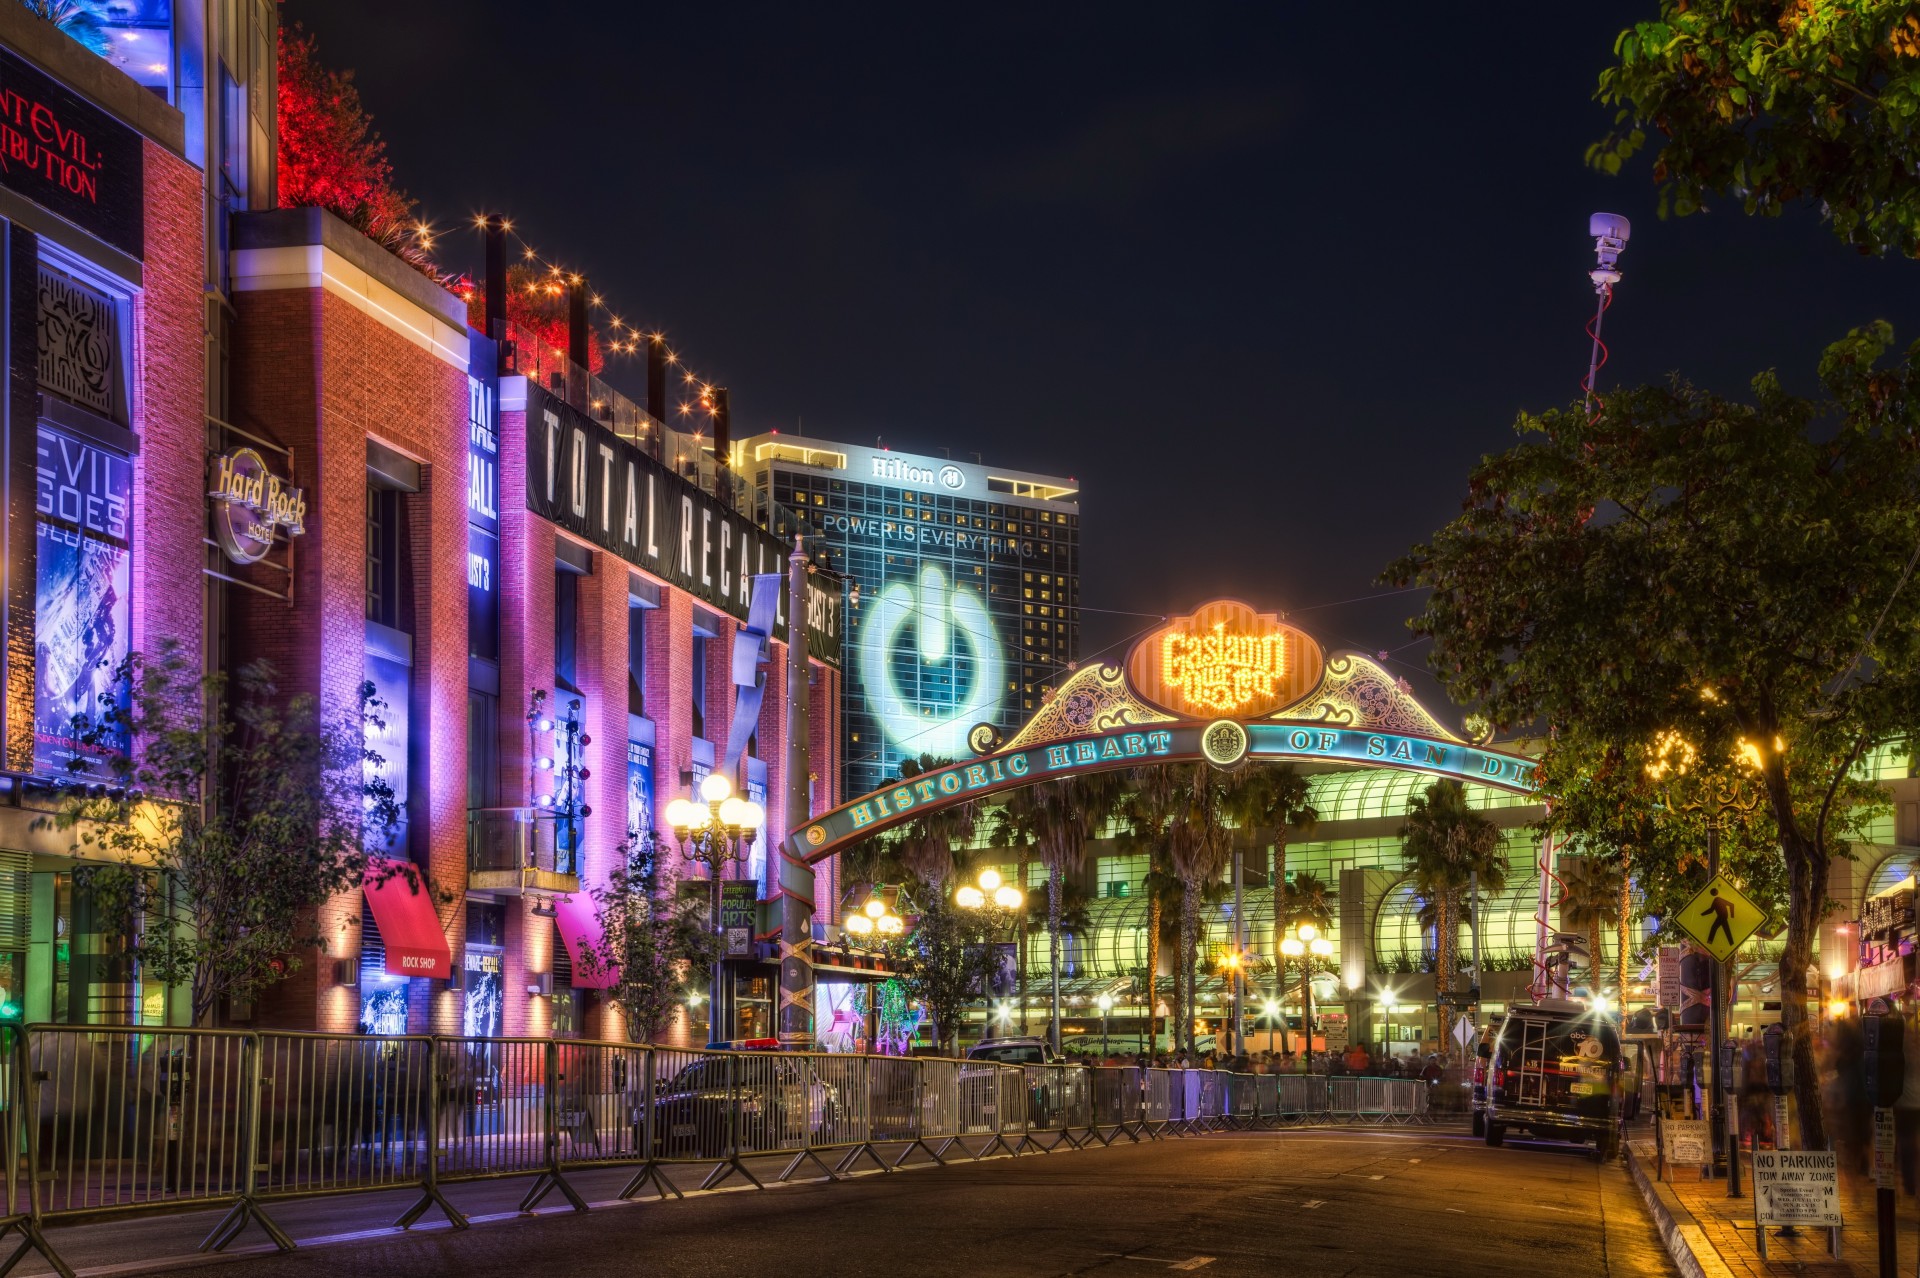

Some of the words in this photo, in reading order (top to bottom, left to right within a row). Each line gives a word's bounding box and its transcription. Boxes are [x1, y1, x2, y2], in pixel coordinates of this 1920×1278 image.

[30, 101, 102, 170] EVIL:
[37, 428, 126, 505] EVIL
[871, 455, 935, 486] Hilton
[37, 476, 126, 539] GOES
[218, 455, 265, 507] Hard
[267, 474, 306, 535] Rock
[248, 521, 275, 545] HOTEL
[544, 408, 658, 558] TOTAL
[828, 597, 834, 638] 3
[823, 514, 892, 539] POWER
[898, 523, 915, 541] IS
[920, 527, 1038, 560] EVERYTHING.
[484, 557, 490, 592] 3
[848, 753, 1029, 829] HISTORIC
[1048, 731, 1170, 768] HEART
[1290, 730, 1338, 752] OF
[1368, 737, 1448, 767] SAN
[722, 899, 756, 910] POPULAR
[722, 910, 756, 926] ARTS
[402, 956, 419, 969] ROCK
[420, 957, 436, 969] SHOP
[1570, 1032, 1586, 1040] abc
[1577, 1037, 1604, 1059] 10
[1756, 1155, 1775, 1168] NO
[1780, 1155, 1835, 1168] PARKING
[1758, 1171, 1778, 1181] TOW
[1781, 1171, 1805, 1181] AWAY
[1809, 1172, 1836, 1182] ZONE
